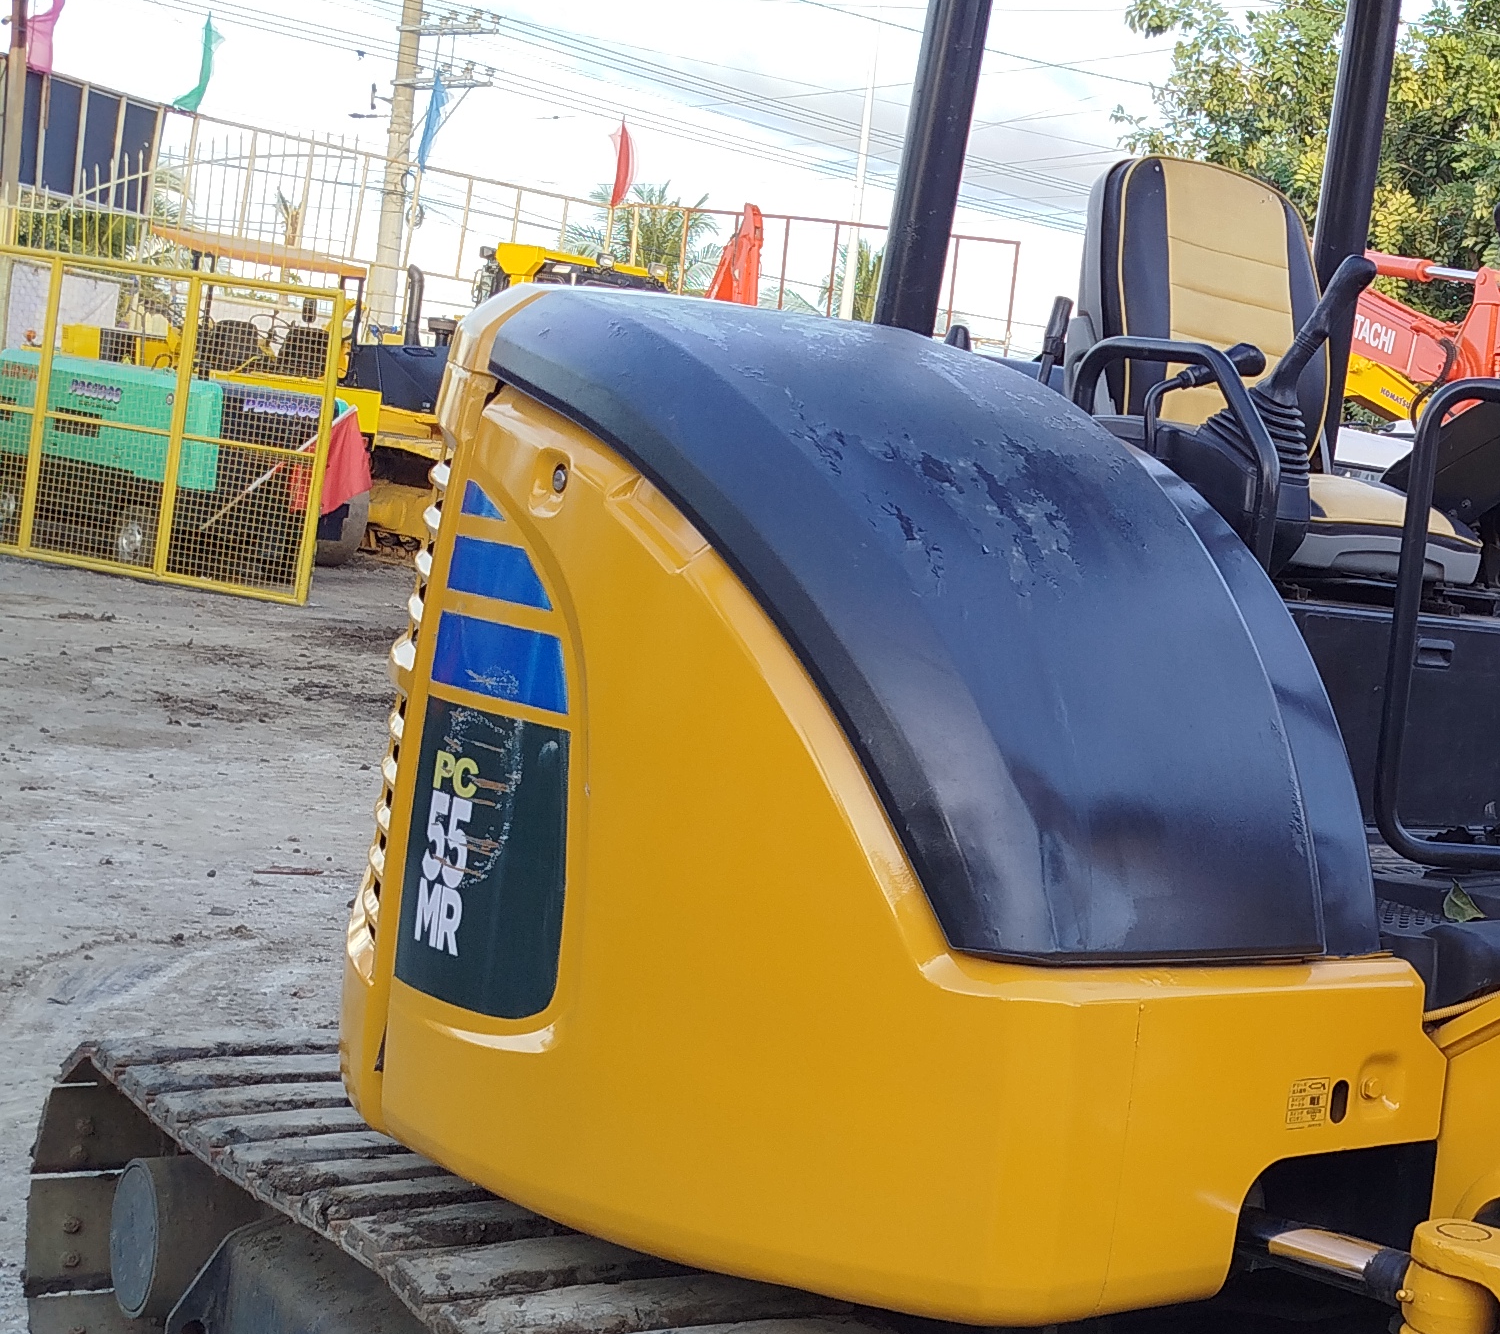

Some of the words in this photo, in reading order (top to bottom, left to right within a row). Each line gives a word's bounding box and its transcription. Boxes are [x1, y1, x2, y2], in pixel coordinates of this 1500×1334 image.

[1354, 313, 1397, 355] TACHI
[432, 749, 479, 798] PC
[421, 789, 473, 889] 55
[414, 876, 463, 957] MR
